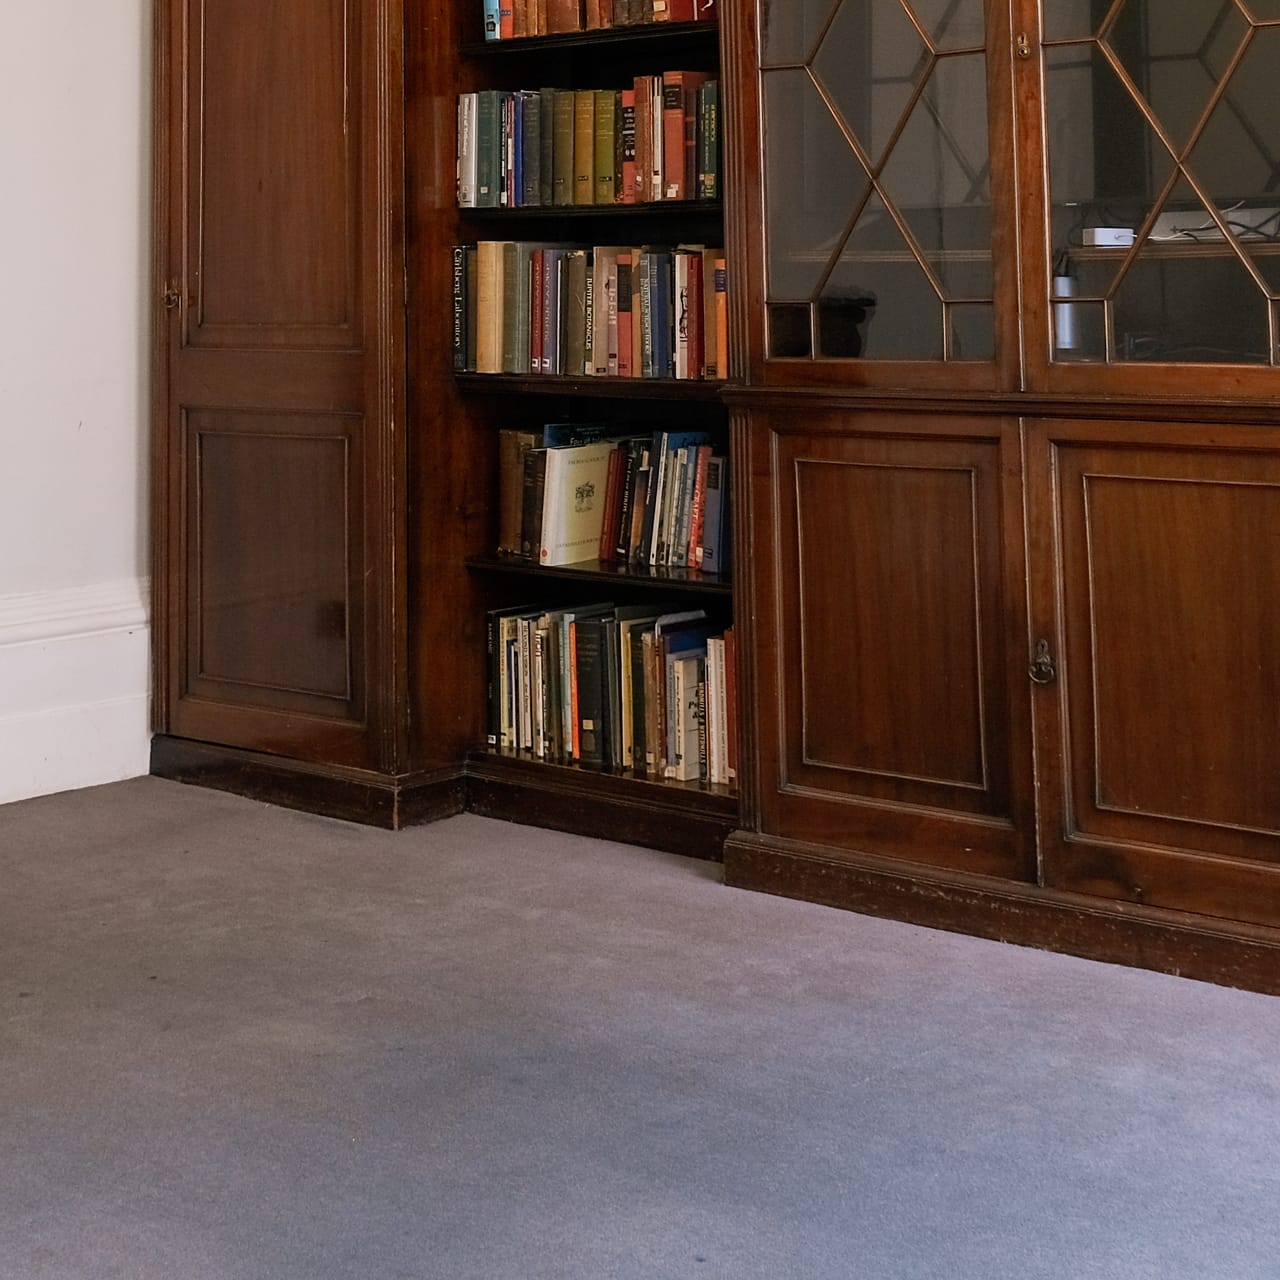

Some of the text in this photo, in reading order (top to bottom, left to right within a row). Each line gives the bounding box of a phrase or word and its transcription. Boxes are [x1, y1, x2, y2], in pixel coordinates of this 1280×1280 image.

[454, 249, 463, 348] Carlsberg Laboratory
[692, 489, 701, 518] CRAFT
